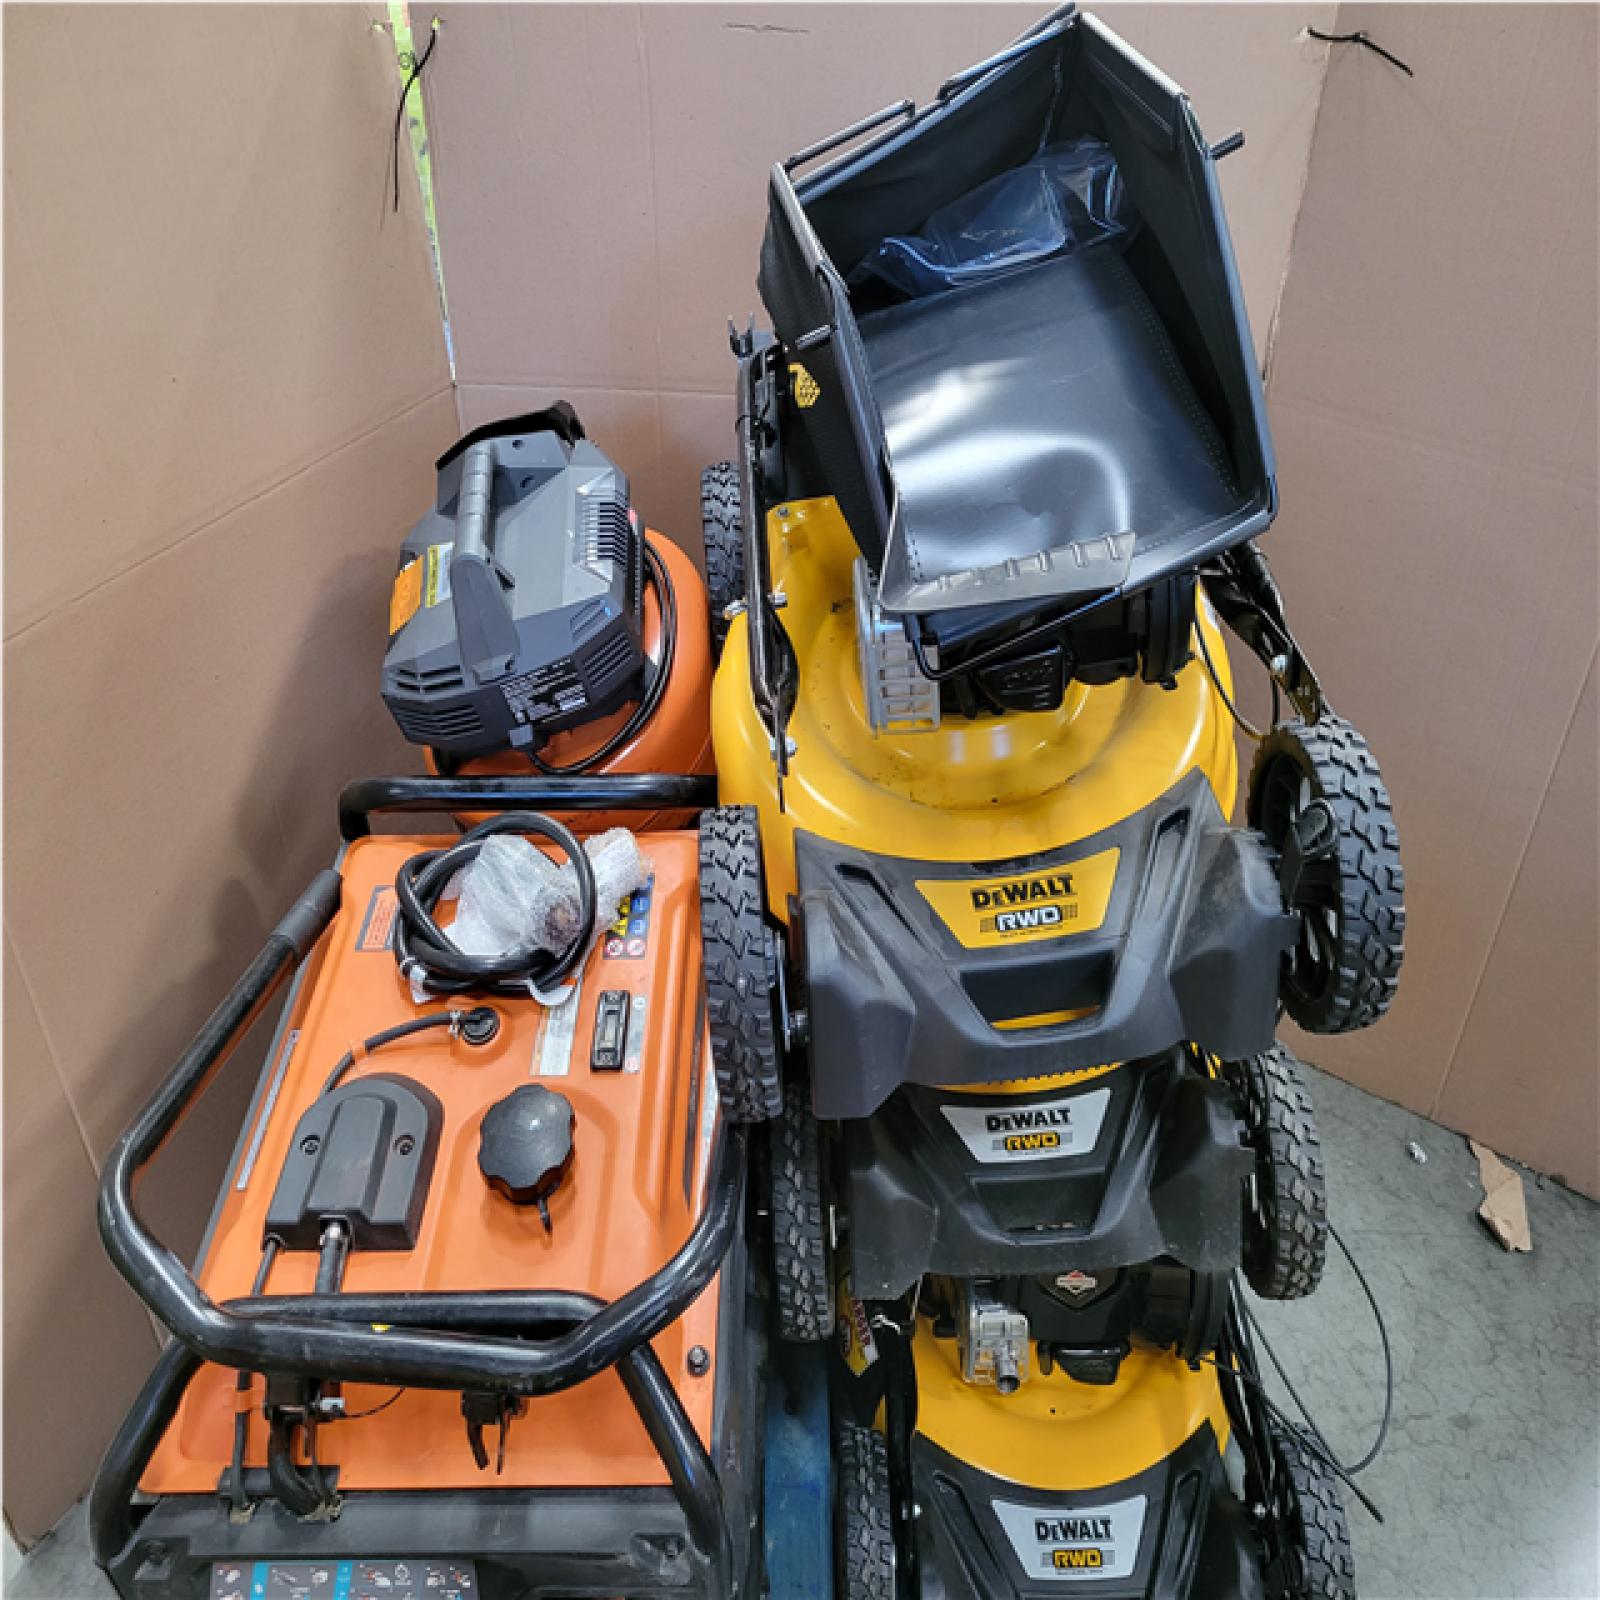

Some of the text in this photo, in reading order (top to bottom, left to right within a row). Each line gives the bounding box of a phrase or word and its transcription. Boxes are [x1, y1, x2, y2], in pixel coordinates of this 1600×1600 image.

[998, 906, 1061, 931] RWD
[1006, 1133, 1058, 1150] RWD
[1054, 1549, 1102, 1567] RWD
